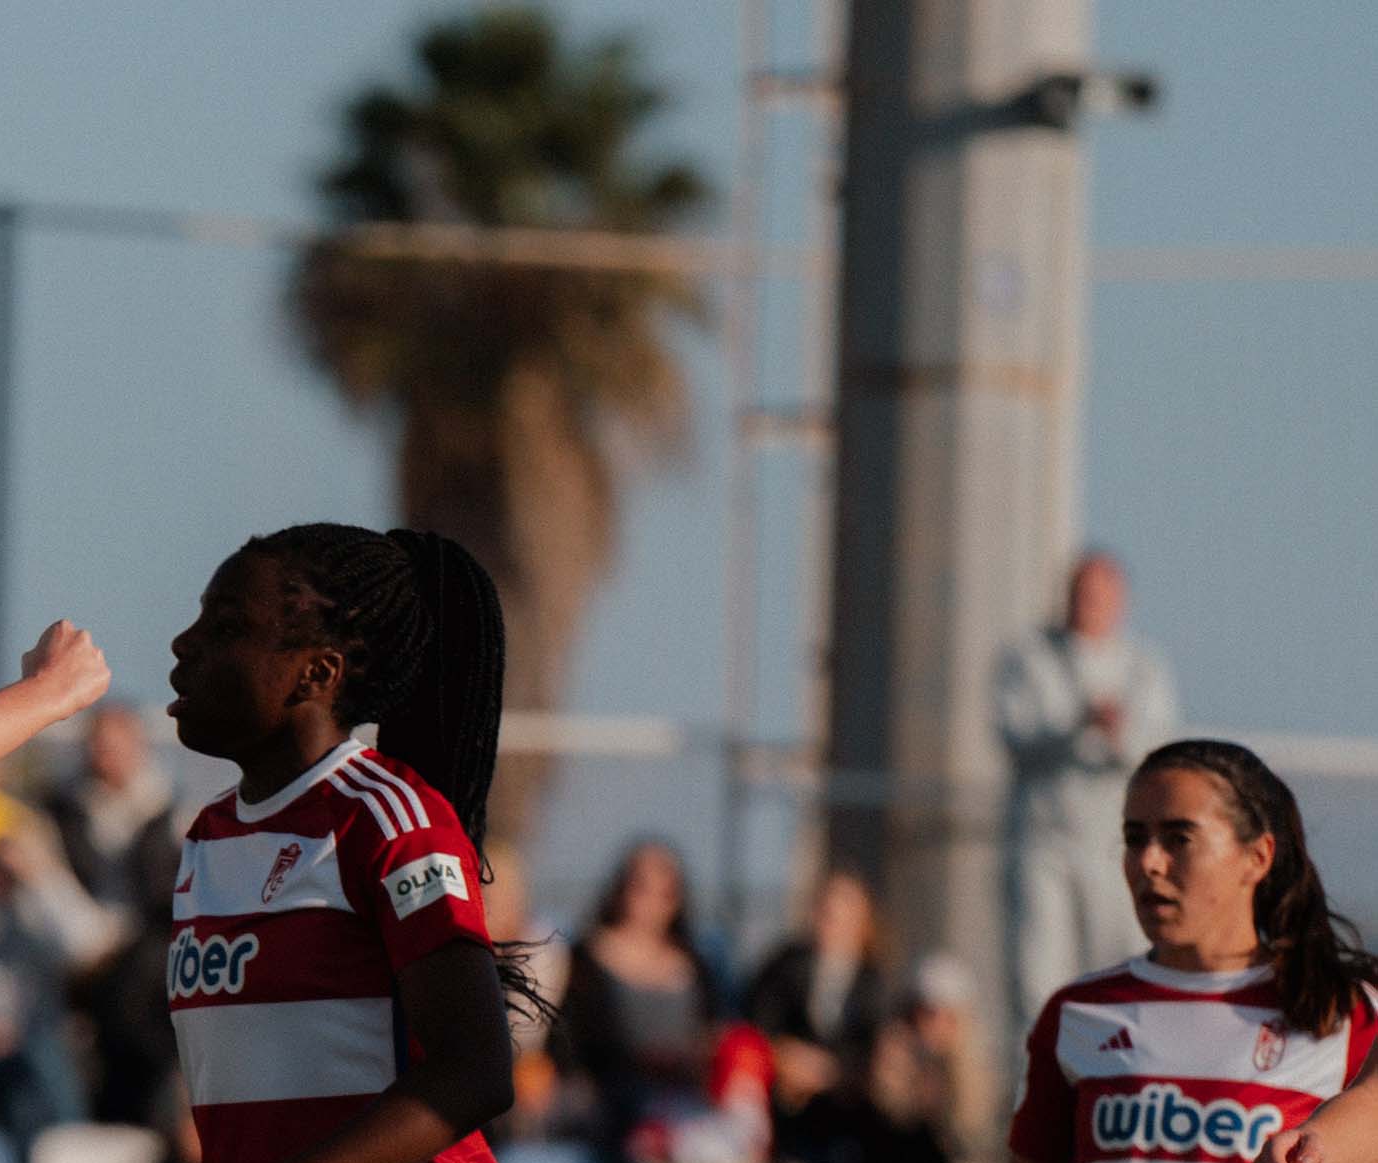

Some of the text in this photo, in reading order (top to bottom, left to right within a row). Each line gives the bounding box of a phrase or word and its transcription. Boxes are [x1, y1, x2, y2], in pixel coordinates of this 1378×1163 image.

[397, 863, 457, 896] OLIVA
[169, 929, 257, 995] iber
[1094, 1086, 1280, 1156] wiber
